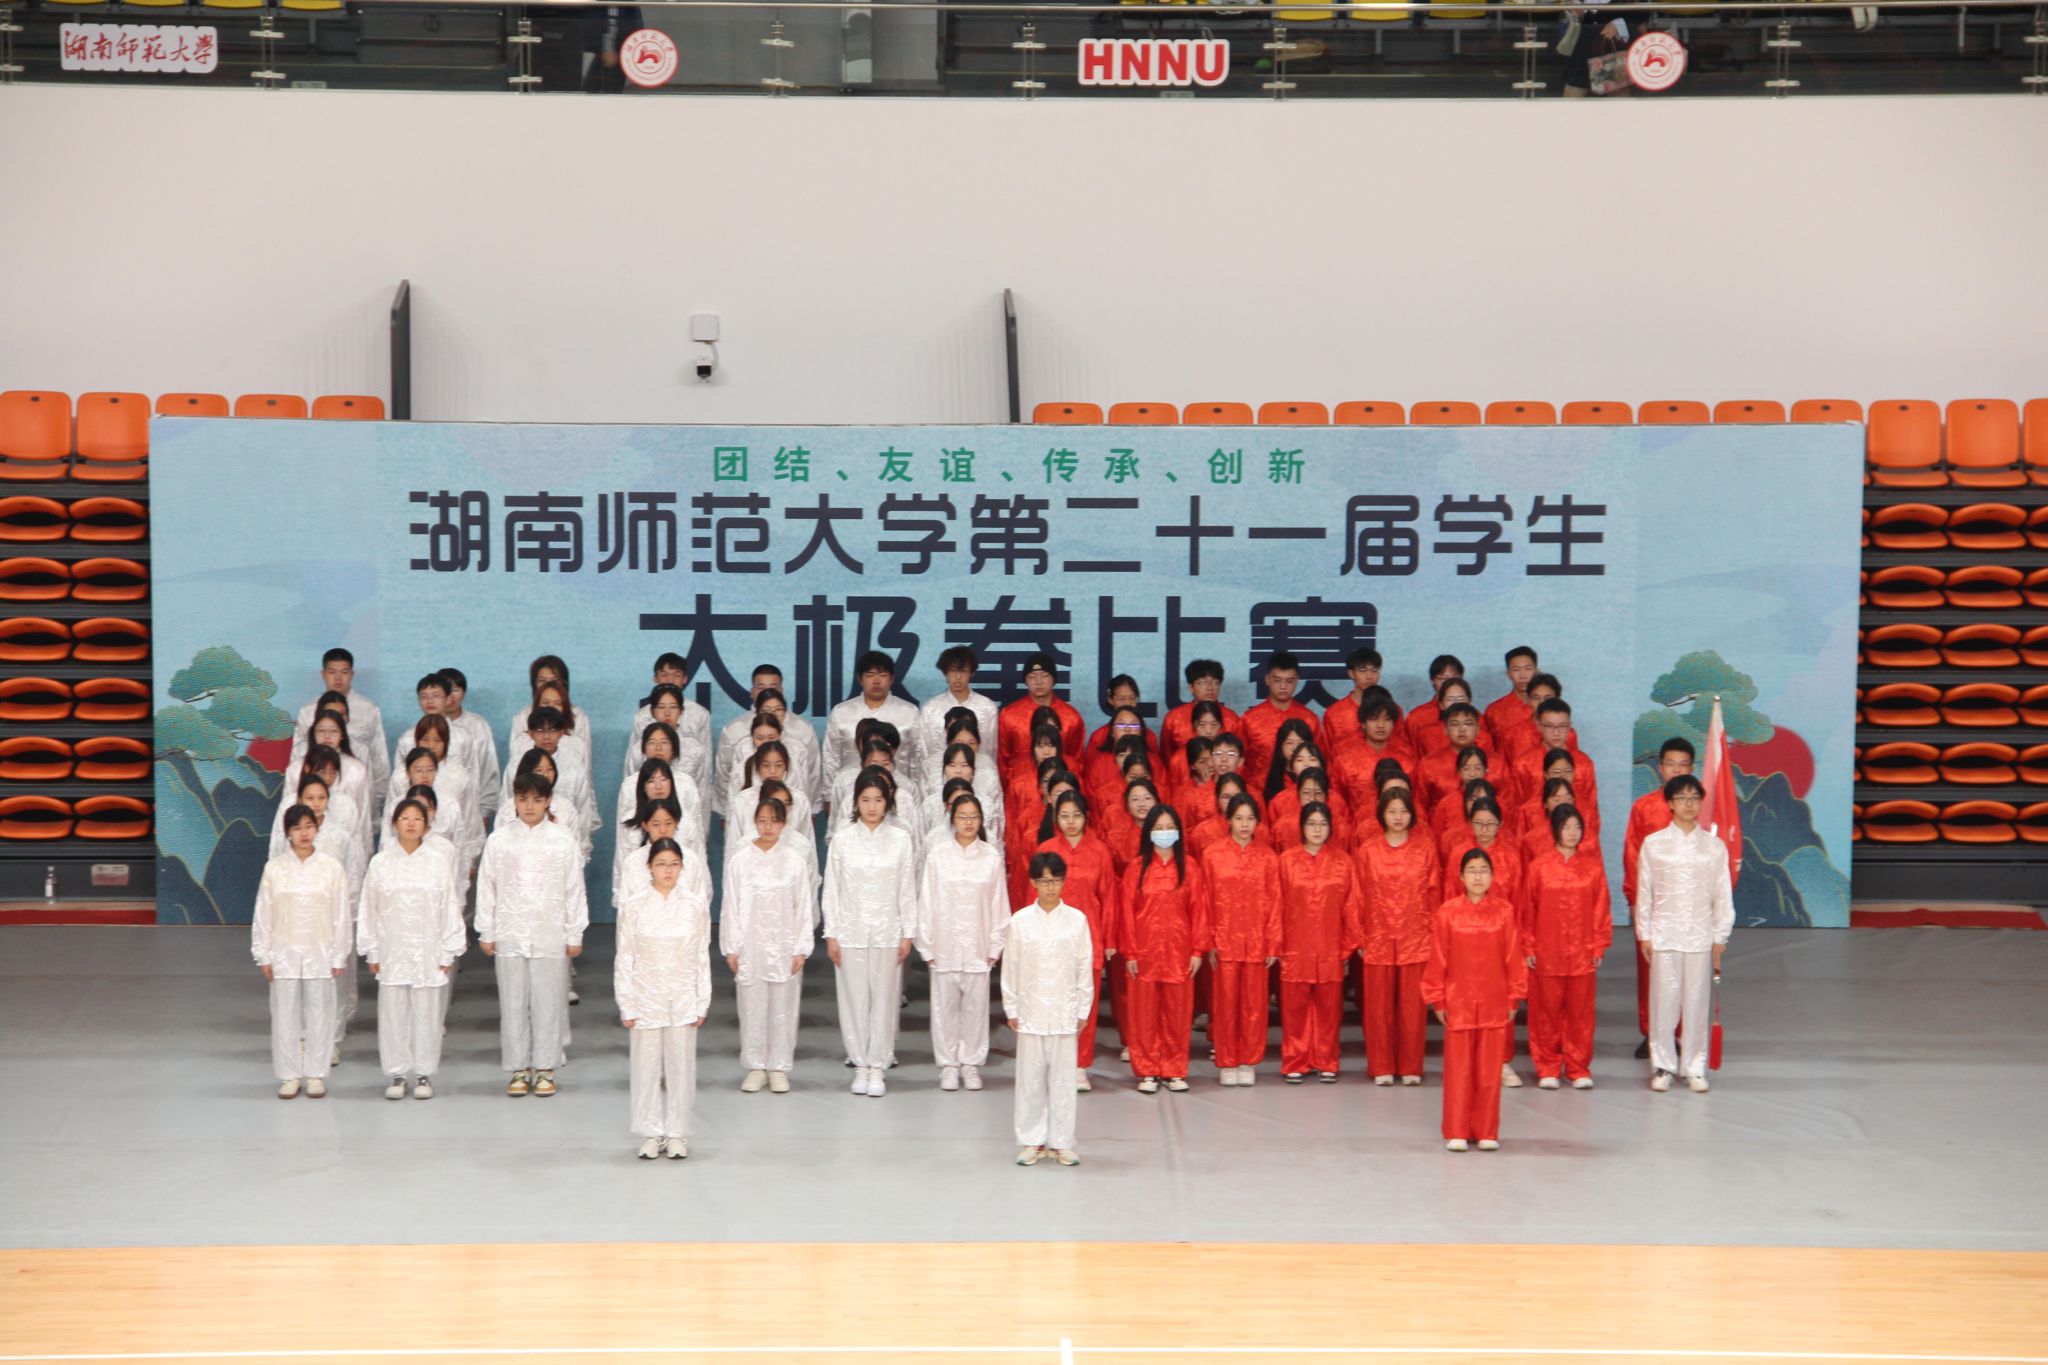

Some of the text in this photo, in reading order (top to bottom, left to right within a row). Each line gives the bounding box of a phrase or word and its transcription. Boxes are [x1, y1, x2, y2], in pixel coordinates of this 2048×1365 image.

[1084, 43, 1225, 81] HNNU
[713, 446, 1306, 484] 团结、友谊、传承、创新
[409, 490, 1606, 575] 湖南师范大学第二十一届学生
[639, 594, 1378, 719] 太极拳比赛
